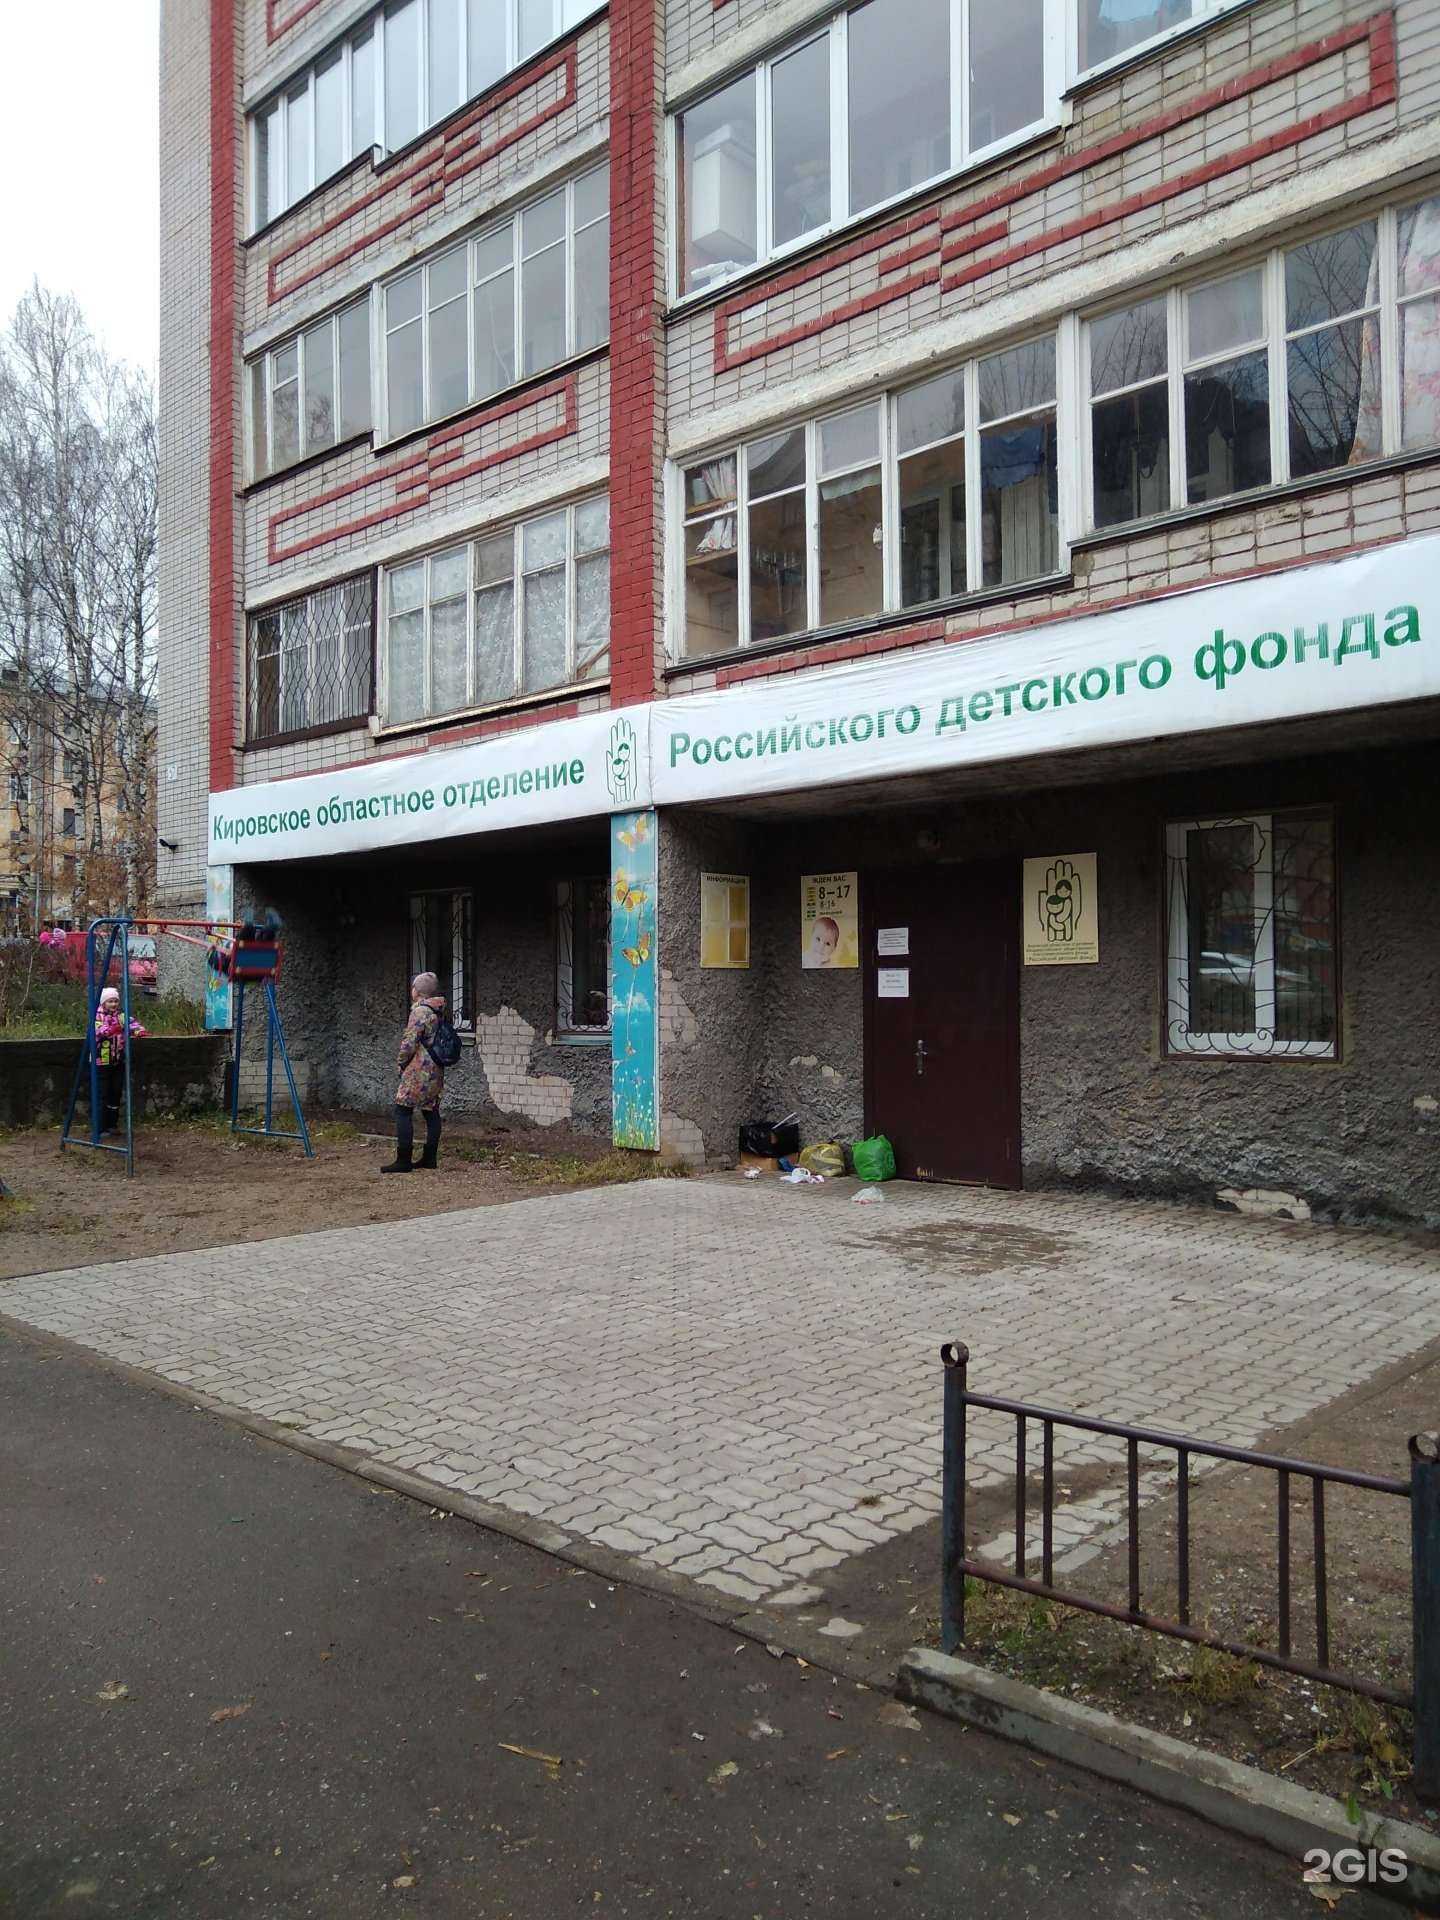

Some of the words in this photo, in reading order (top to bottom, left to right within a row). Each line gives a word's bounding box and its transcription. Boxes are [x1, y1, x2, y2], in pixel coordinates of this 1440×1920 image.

[669, 702, 922, 768] Российского
[936, 655, 1173, 735] детского
[1193, 602, 1422, 694] фонда
[212, 807, 310, 843] Кировское
[315, 788, 436, 827] областное
[443, 757, 585, 807] отделение
